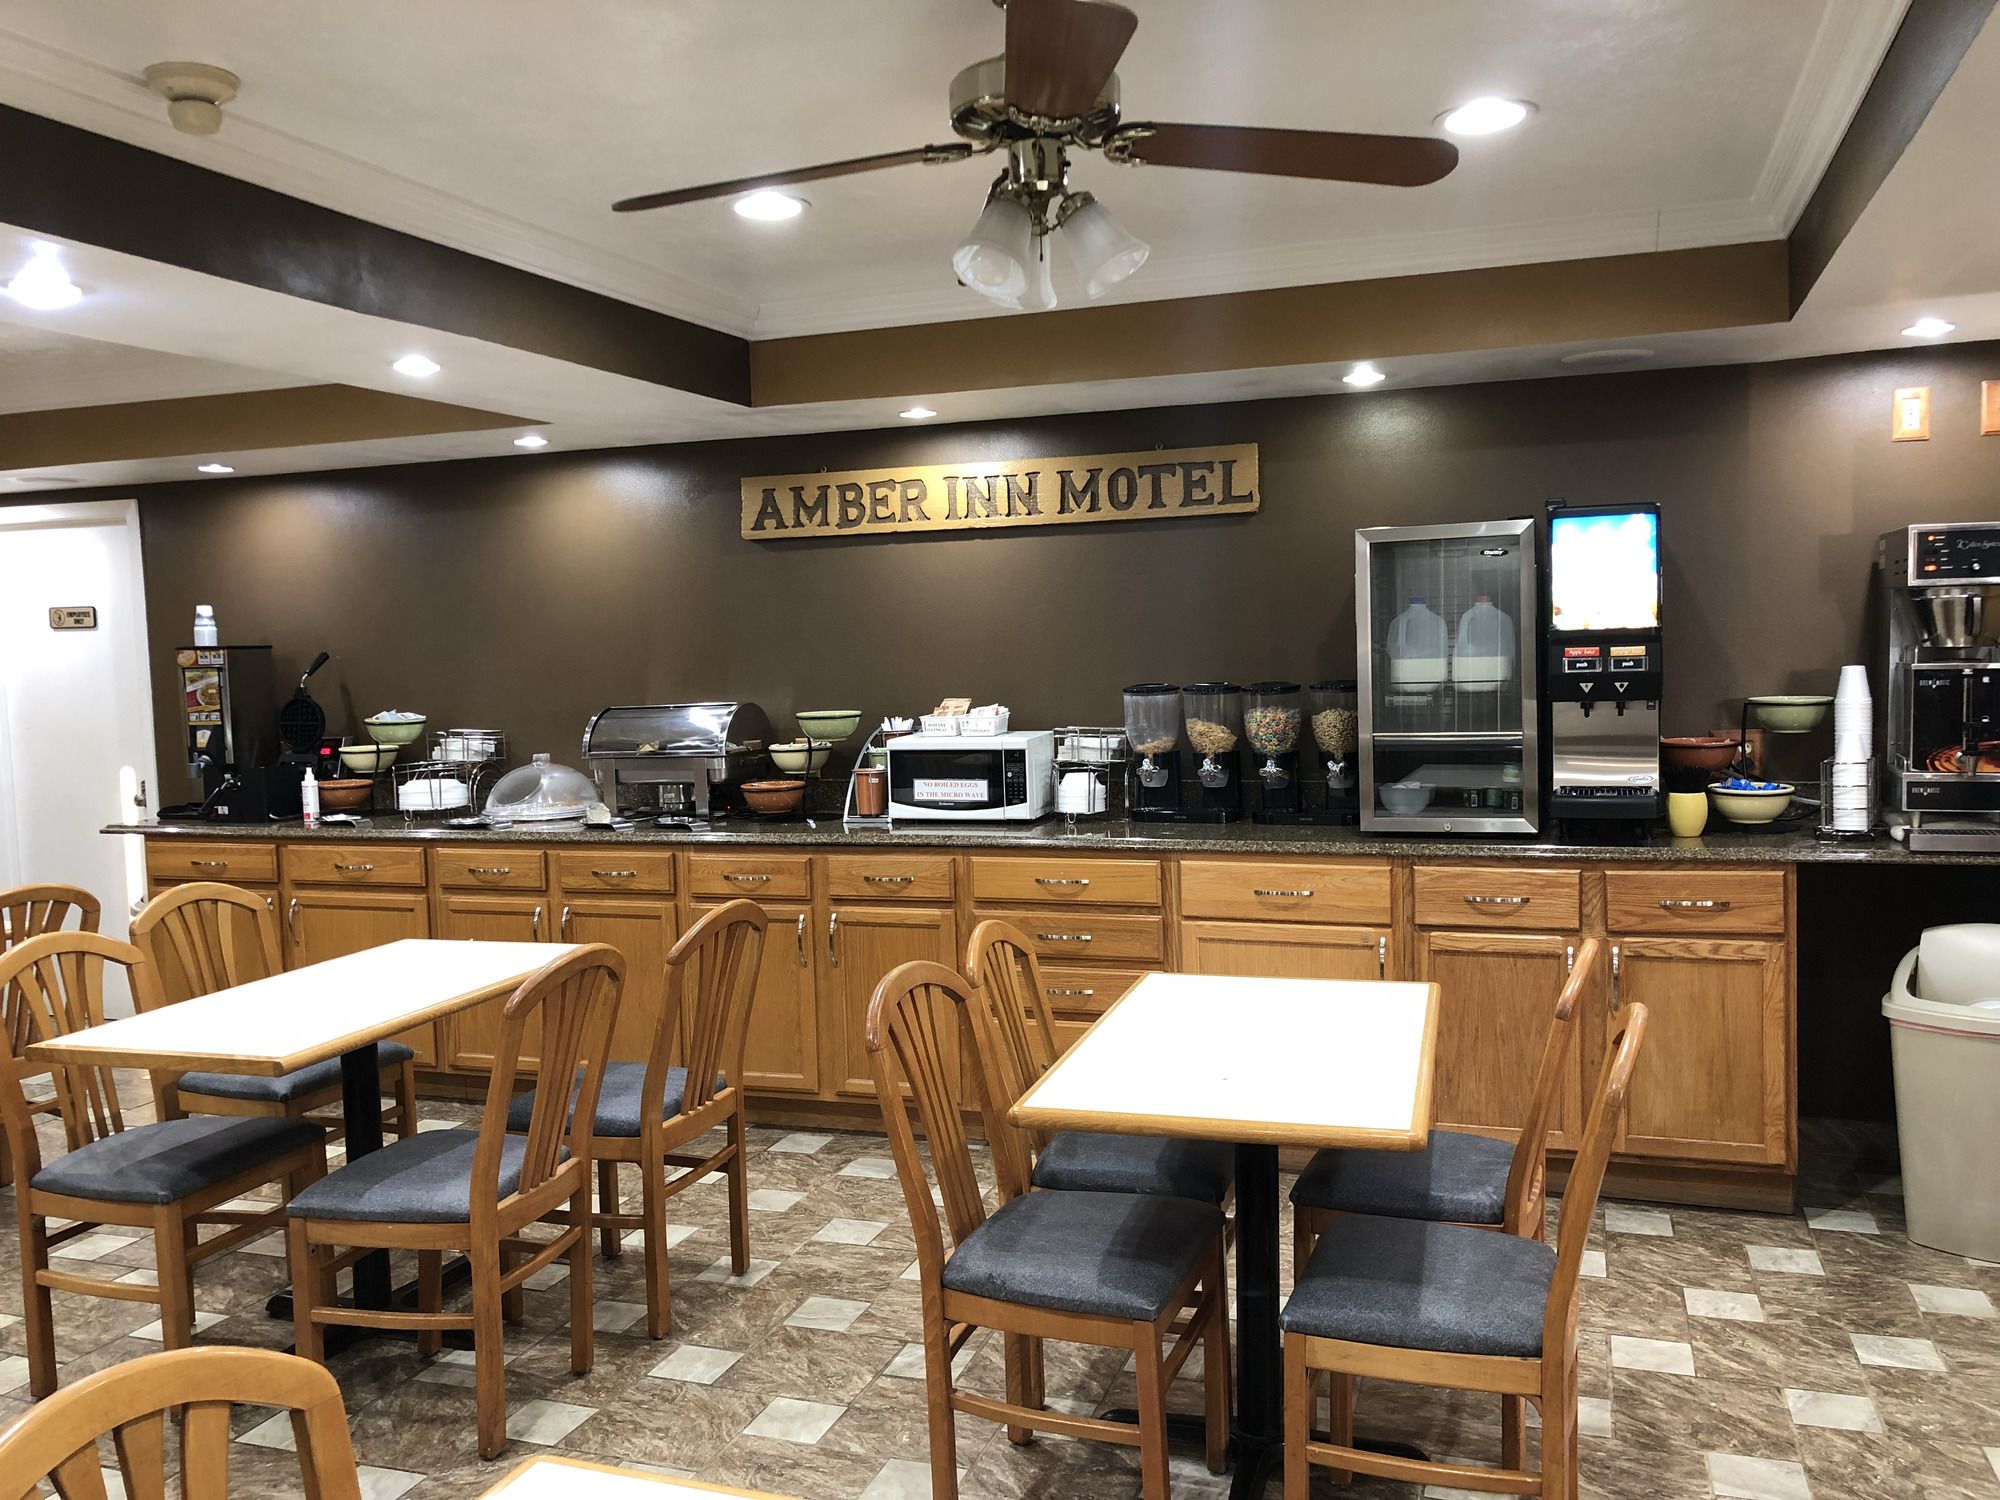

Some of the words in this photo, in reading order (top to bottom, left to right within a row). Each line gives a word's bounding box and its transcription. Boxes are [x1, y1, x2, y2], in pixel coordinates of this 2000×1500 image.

[751, 479, 931, 531] AMBER
[943, 472, 1044, 520] INN
[1056, 460, 1254, 514] MOTEL
